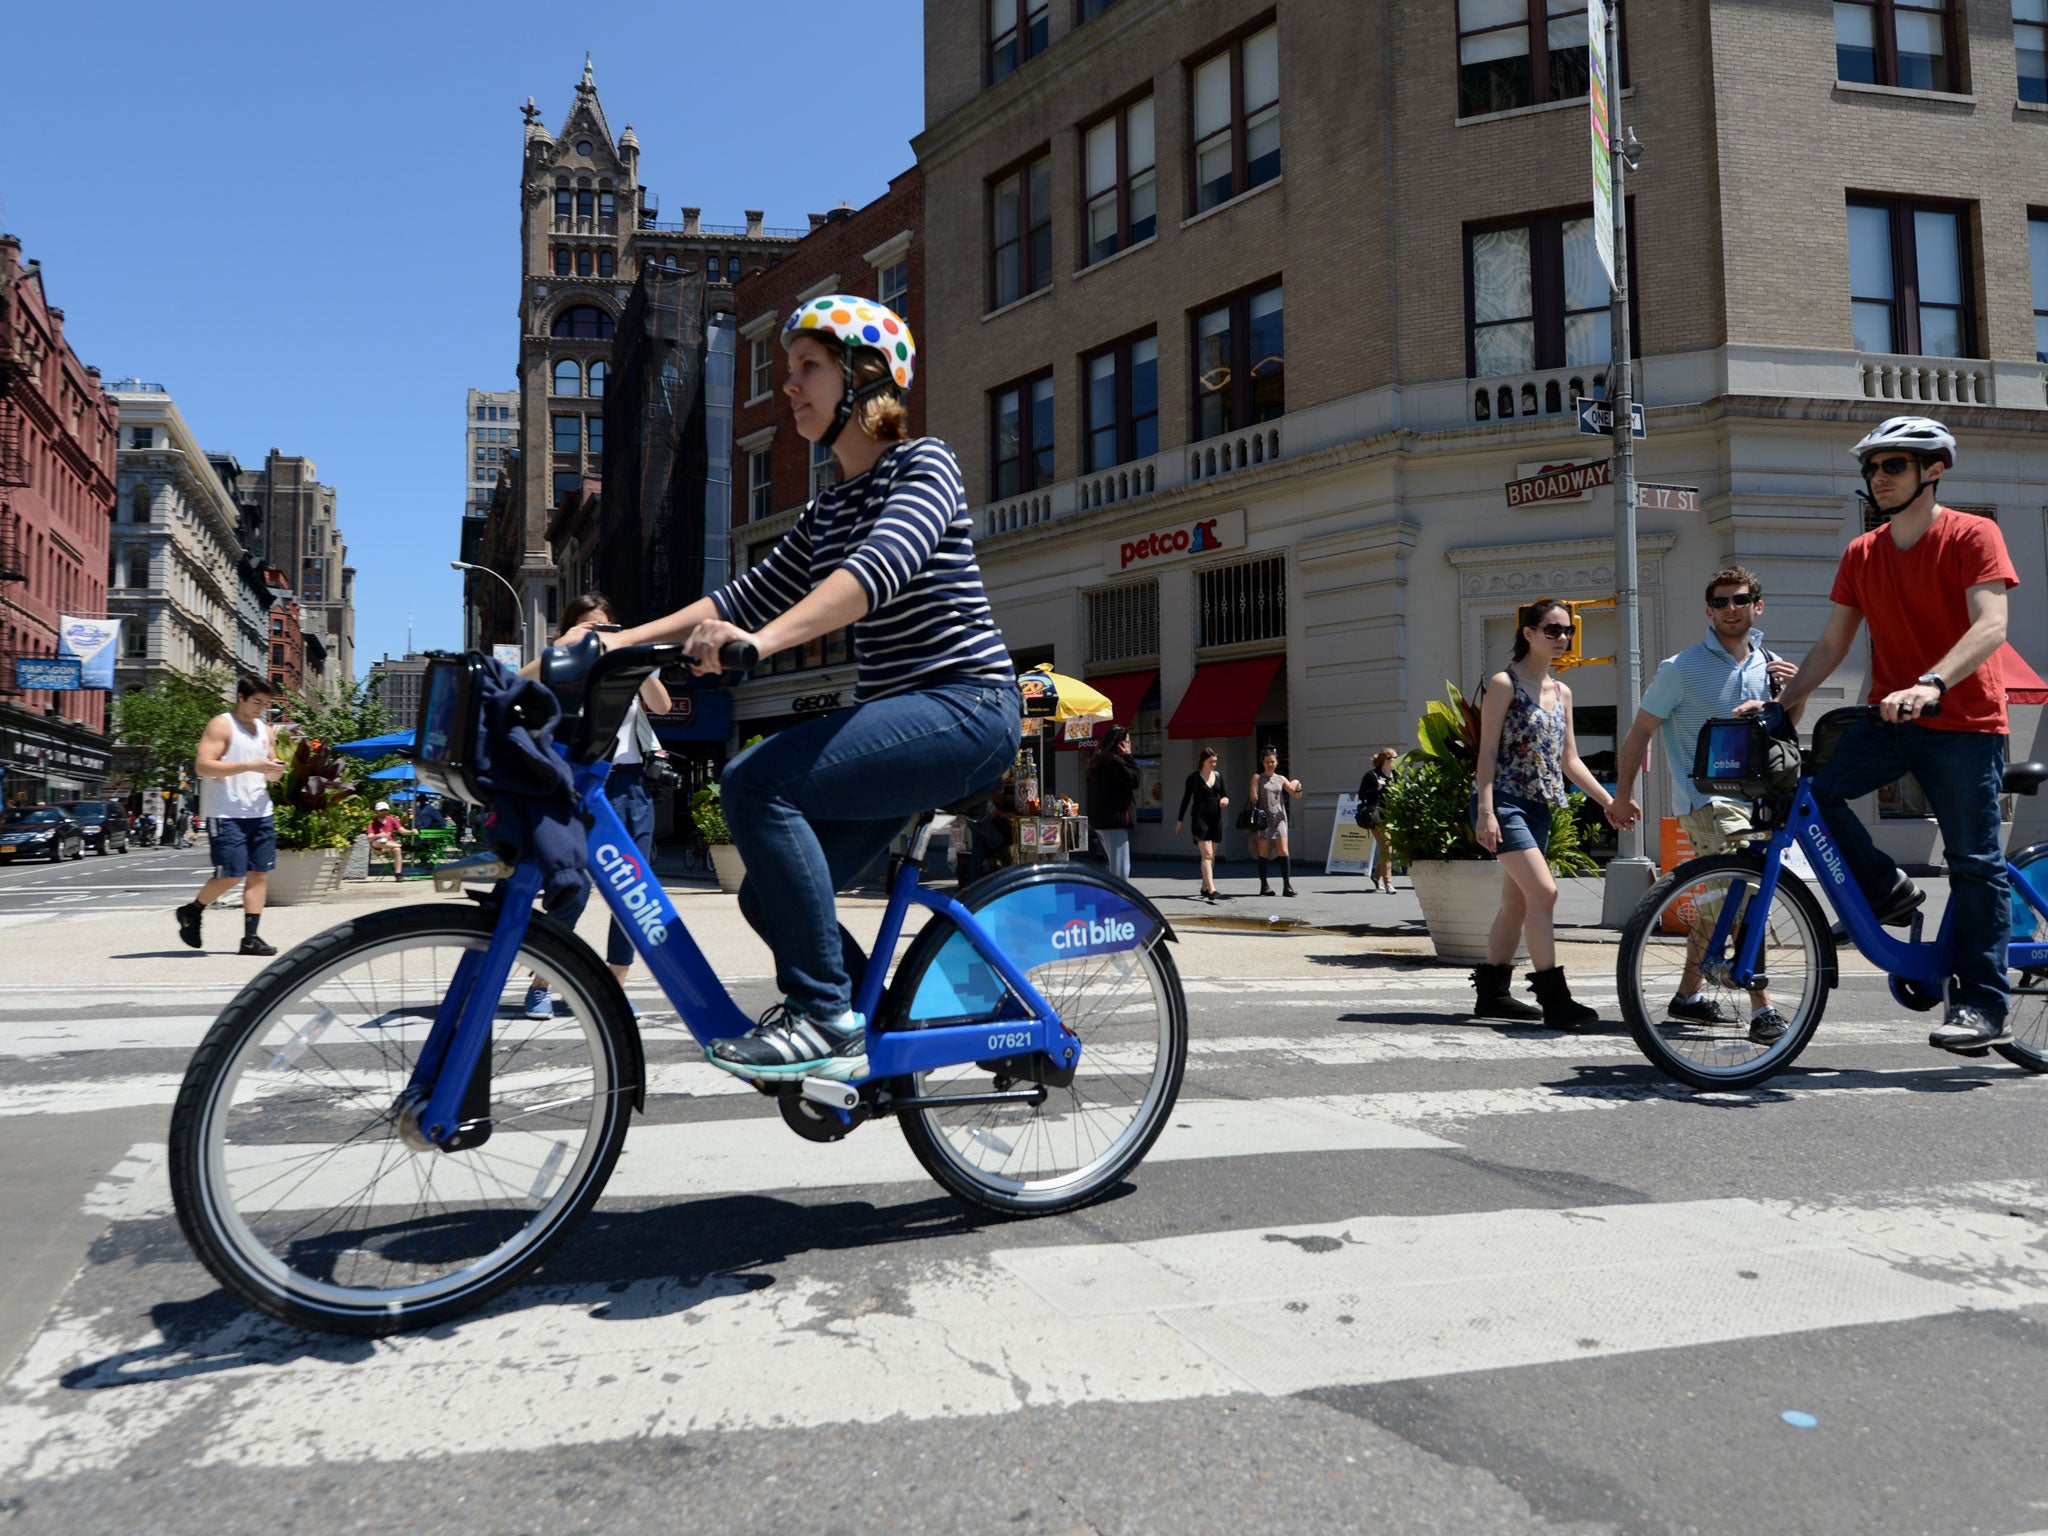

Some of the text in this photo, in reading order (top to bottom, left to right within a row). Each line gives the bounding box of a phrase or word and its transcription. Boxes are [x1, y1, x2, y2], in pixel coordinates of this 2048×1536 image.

[1591, 410, 1610, 425] ONE
[1508, 463, 1606, 505] BROADWAY
[1639, 487, 1696, 511] E 17 ST
[1121, 529, 1189, 569] petco
[20, 665, 76, 675] PARAGON
[26, 675, 71, 684] SPORTS
[792, 692, 842, 712] GEOX
[1078, 740, 1099, 748] petco
[1808, 824, 1845, 884] citi bike
[596, 844, 668, 946] citi bike
[1051, 917, 1135, 950] citi bike
[988, 1031, 1031, 1050] 07621
